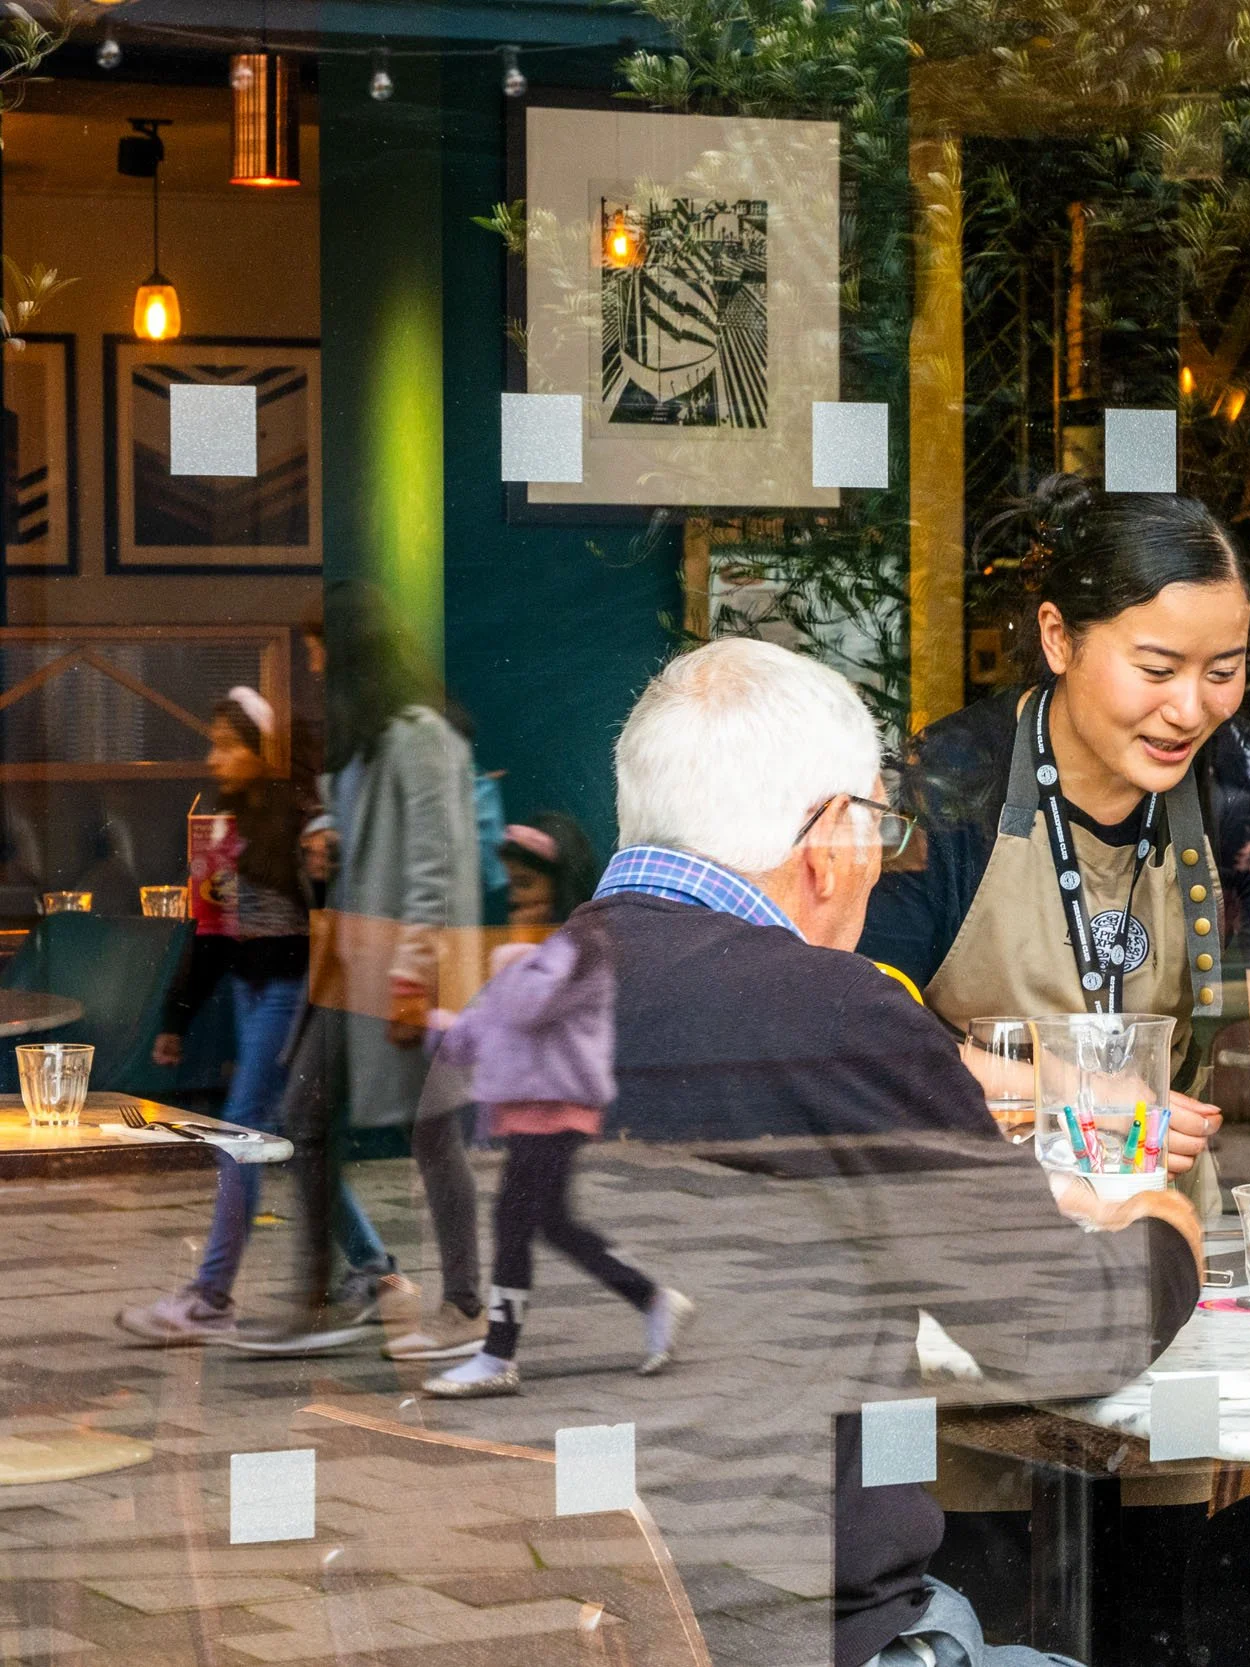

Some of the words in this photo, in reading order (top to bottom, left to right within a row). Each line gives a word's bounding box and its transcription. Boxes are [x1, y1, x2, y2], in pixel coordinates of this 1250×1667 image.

[1049, 796, 1065, 843] PIZZAEXPRESS
[1060, 843, 1068, 860] CLUB
[1082, 945, 1091, 962] CLUB
